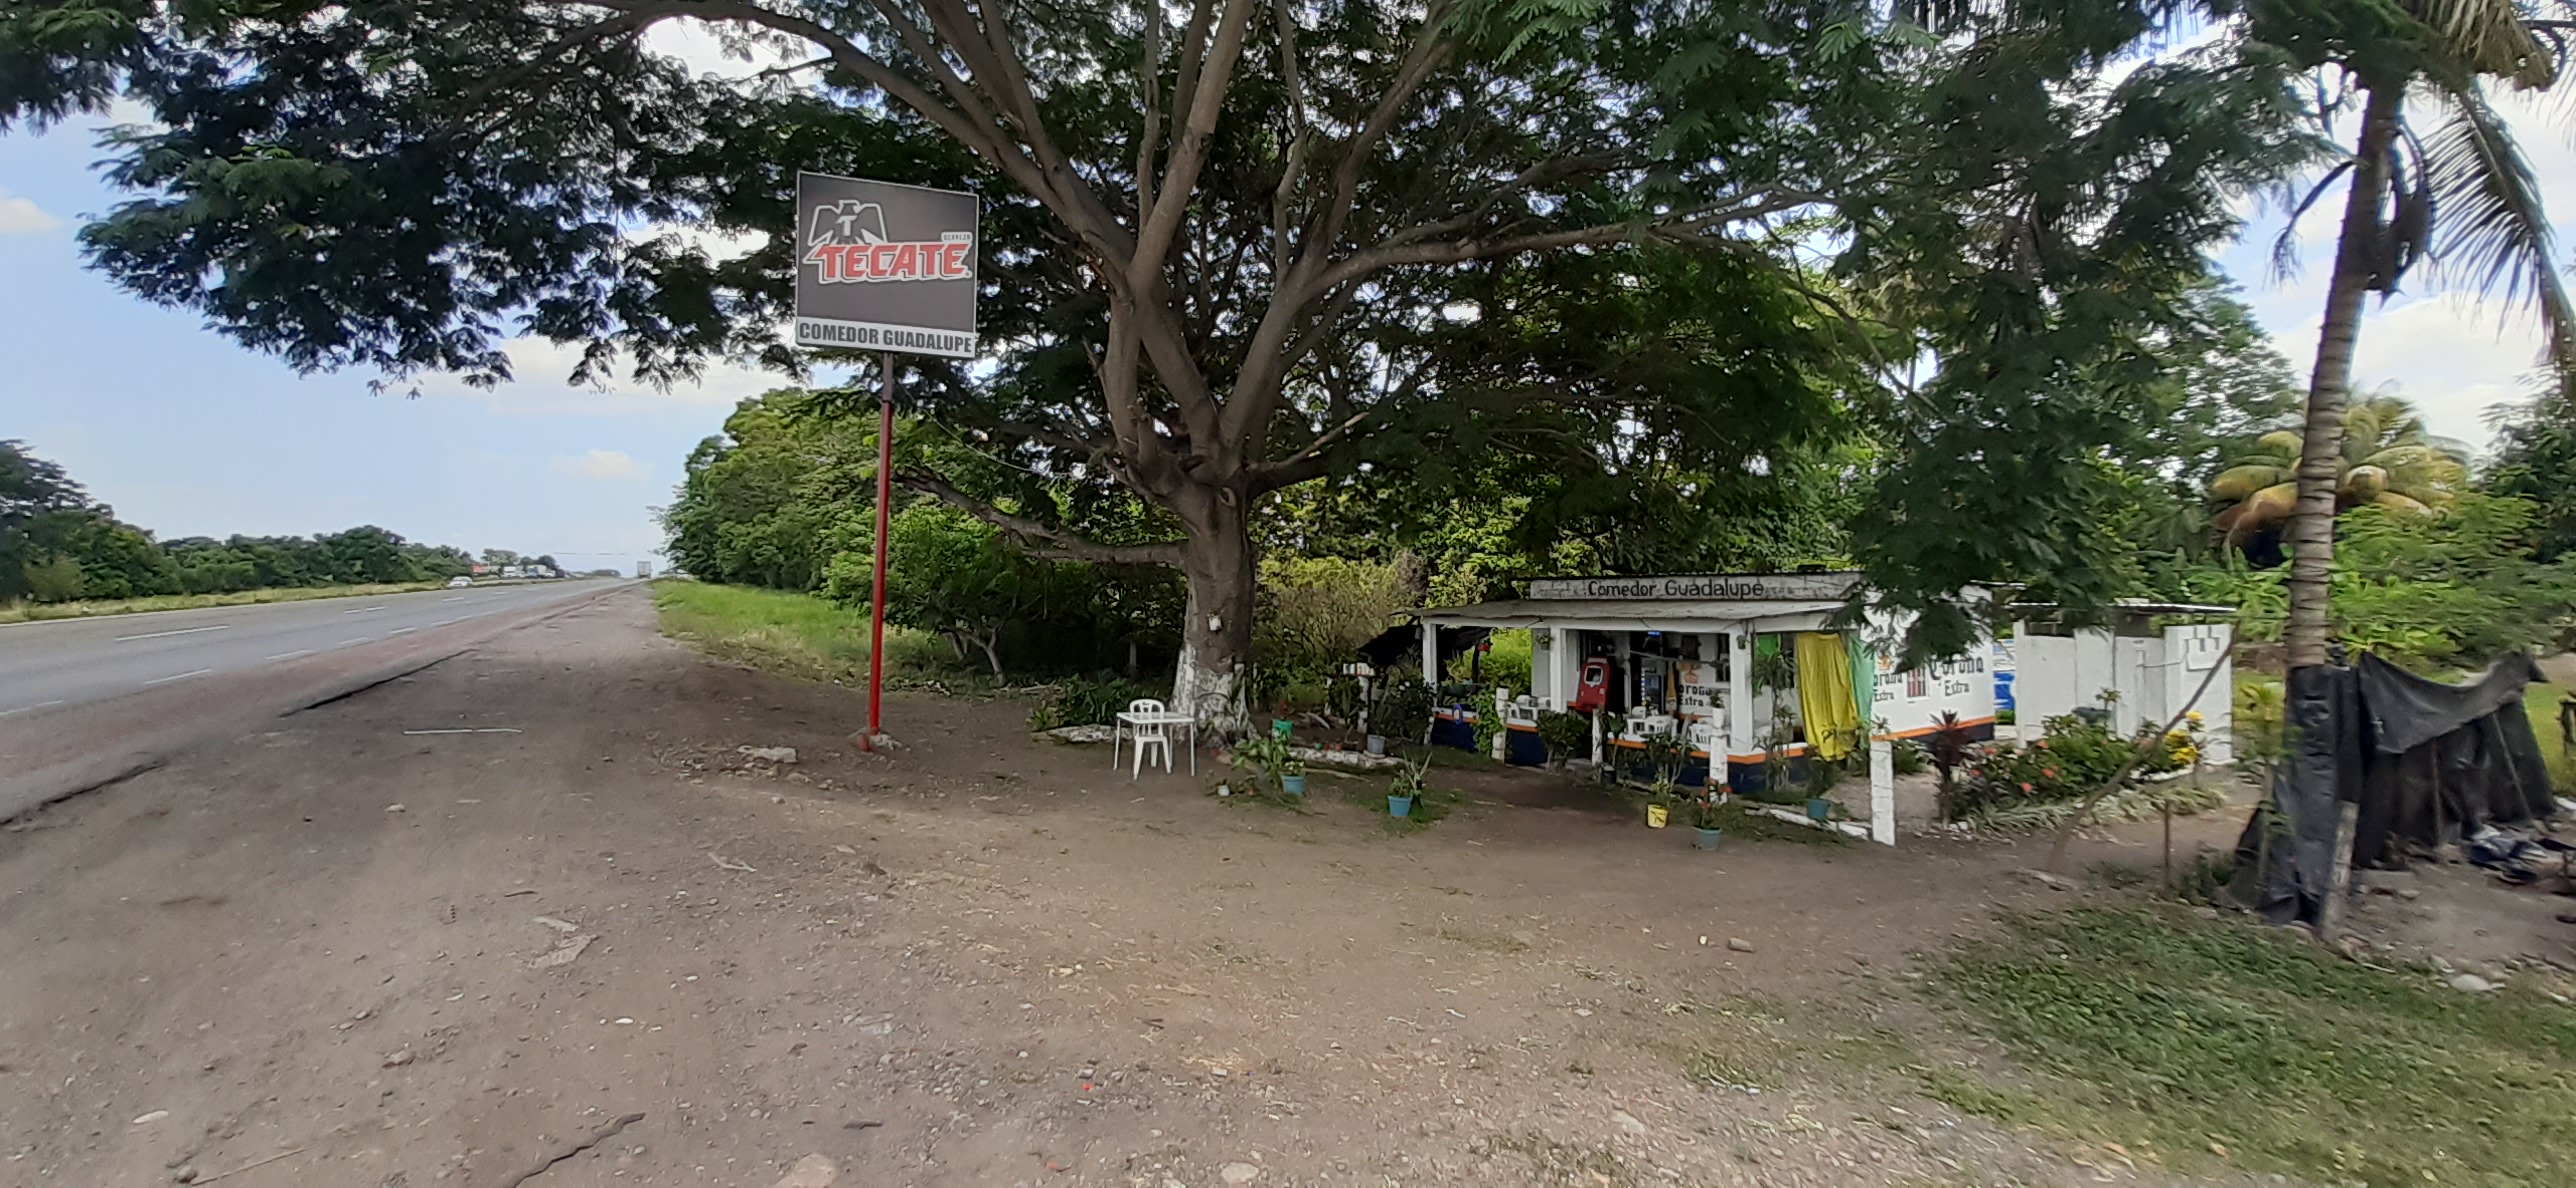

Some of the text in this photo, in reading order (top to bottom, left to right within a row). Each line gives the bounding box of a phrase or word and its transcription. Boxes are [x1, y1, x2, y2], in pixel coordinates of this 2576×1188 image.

[812, 242, 971, 280] TECATE
[800, 322, 972, 353] COMEDOR GUADALUPE
[1588, 580, 1656, 597] Comedor
[1664, 579, 1764, 599] Guadalupe
